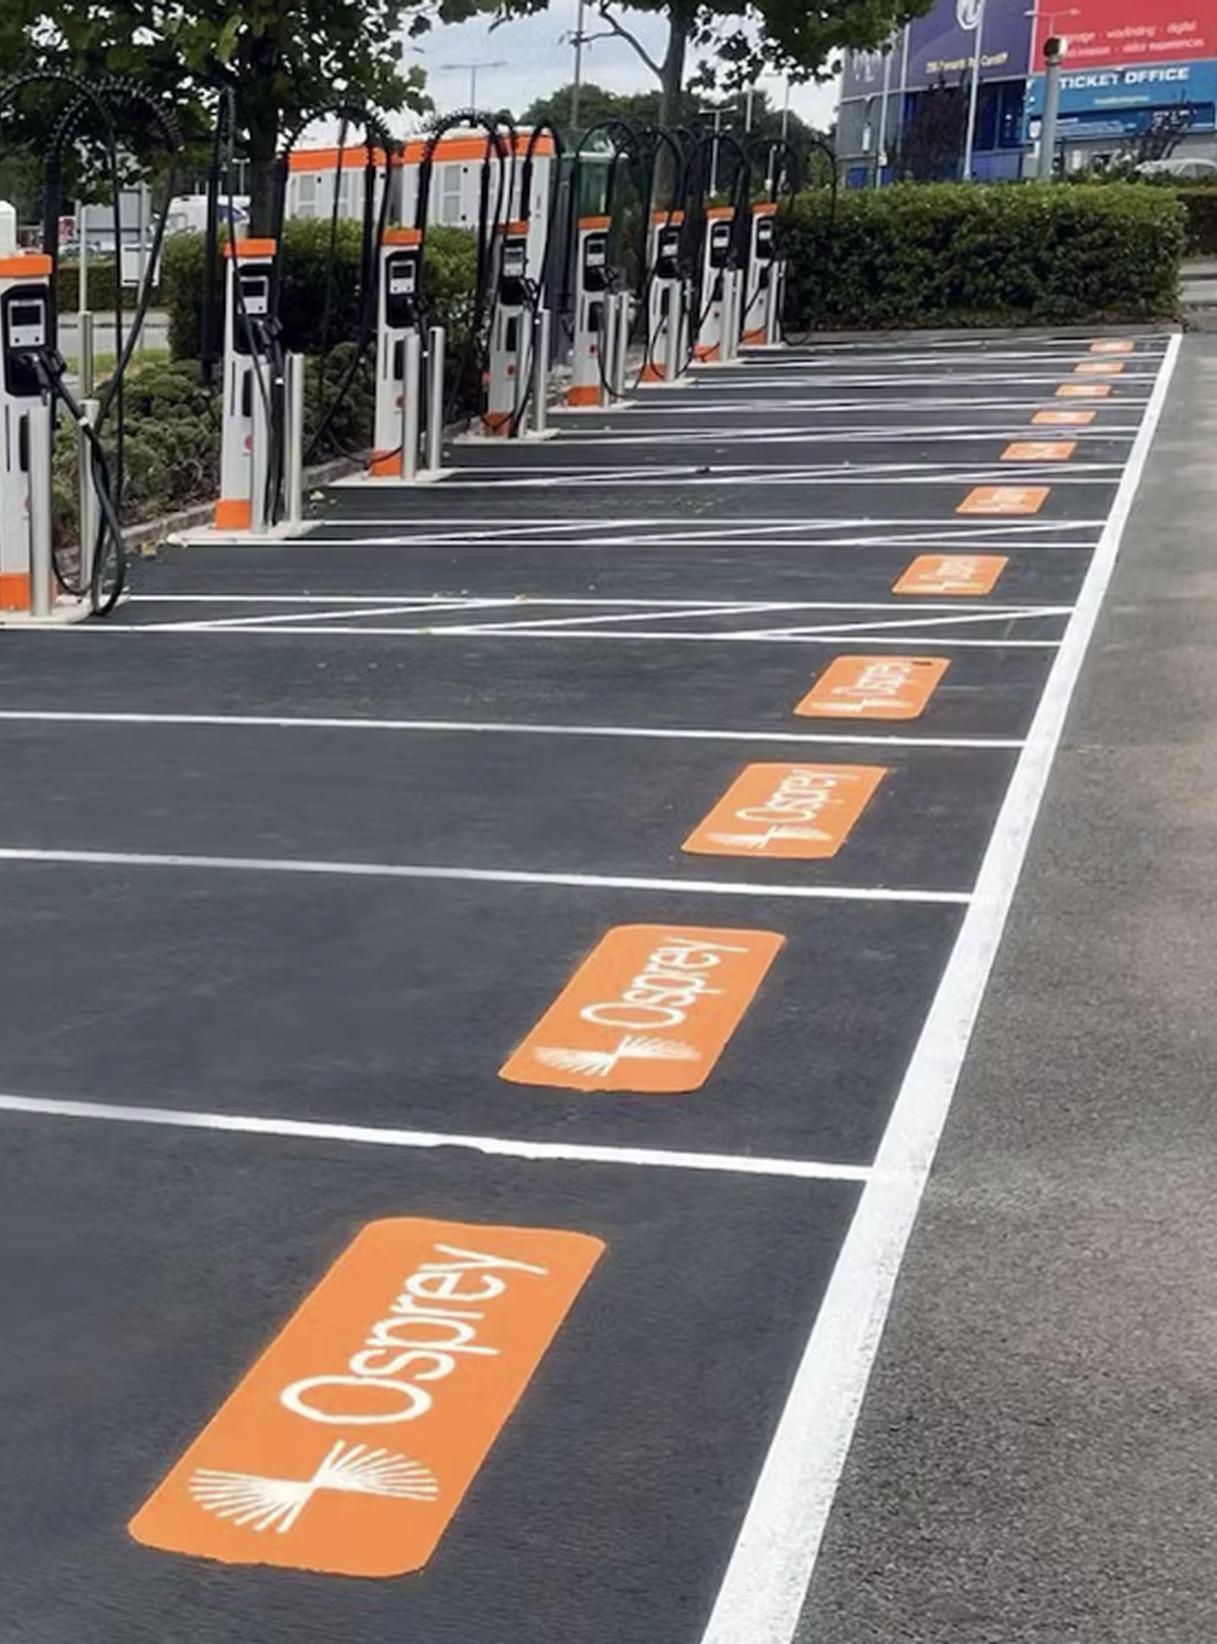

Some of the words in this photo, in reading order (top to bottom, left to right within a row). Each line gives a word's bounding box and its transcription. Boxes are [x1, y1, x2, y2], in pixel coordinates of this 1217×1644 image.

[1060, 73, 1119, 90] TICKET
[1125, 67, 1190, 84] OFFICE
[580, 936, 749, 1028] Osprey
[280, 1243, 548, 1424] Osprey
